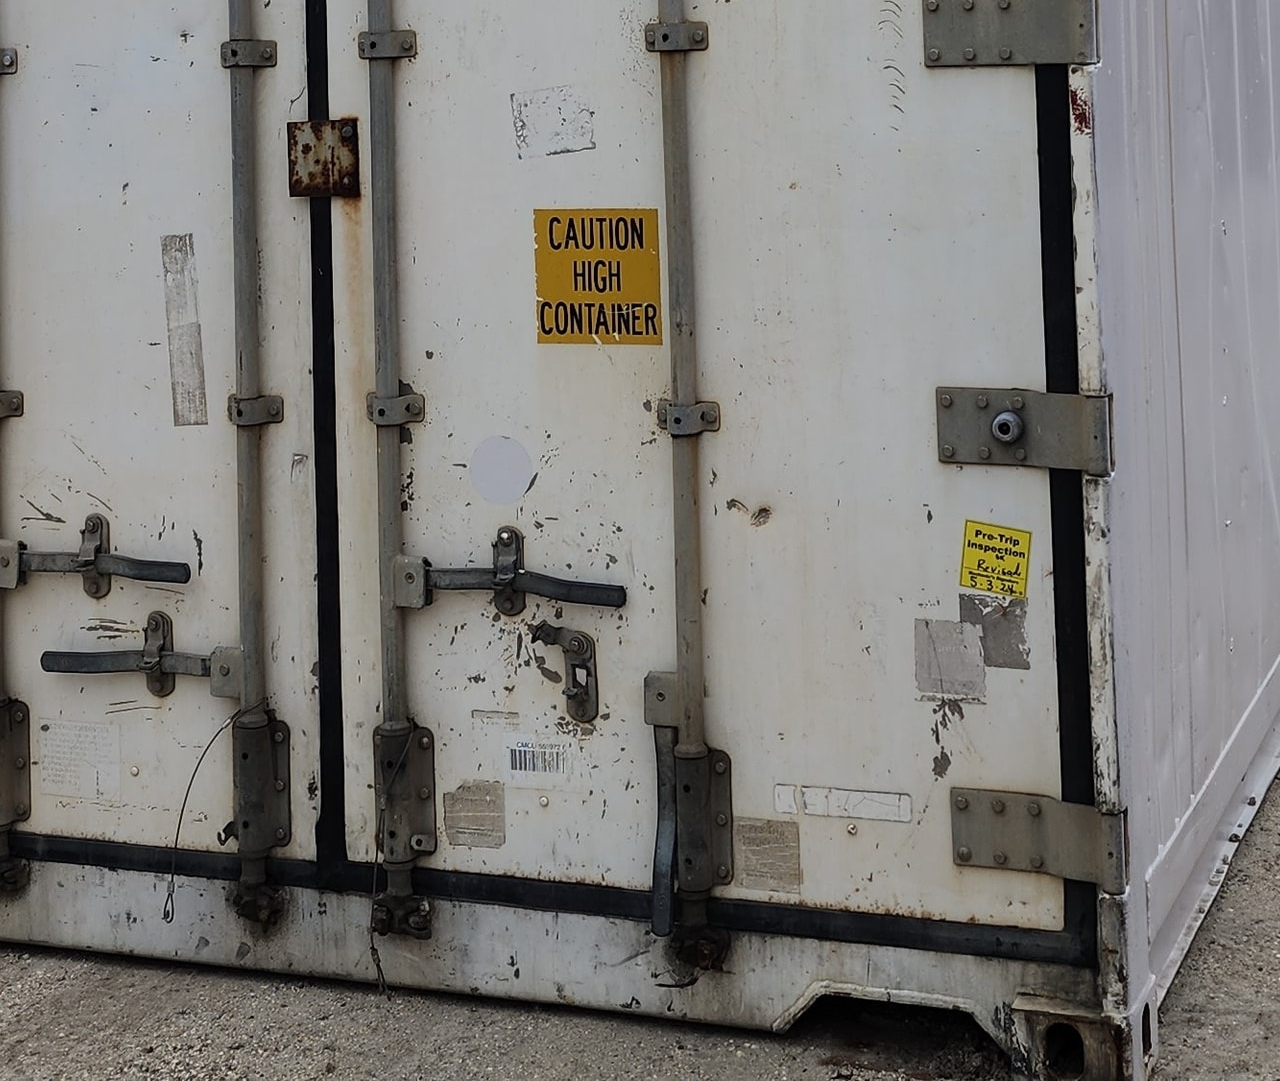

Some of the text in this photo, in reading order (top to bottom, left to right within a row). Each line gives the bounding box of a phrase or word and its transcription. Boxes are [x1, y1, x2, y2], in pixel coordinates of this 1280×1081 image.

[549, 217, 644, 250] CAUTION
[573, 260, 621, 293] HIGH
[539, 301, 658, 336] CONTAINER
[967, 540, 1026, 559] Inspection
[975, 529, 1020, 547] Pre-Trip
